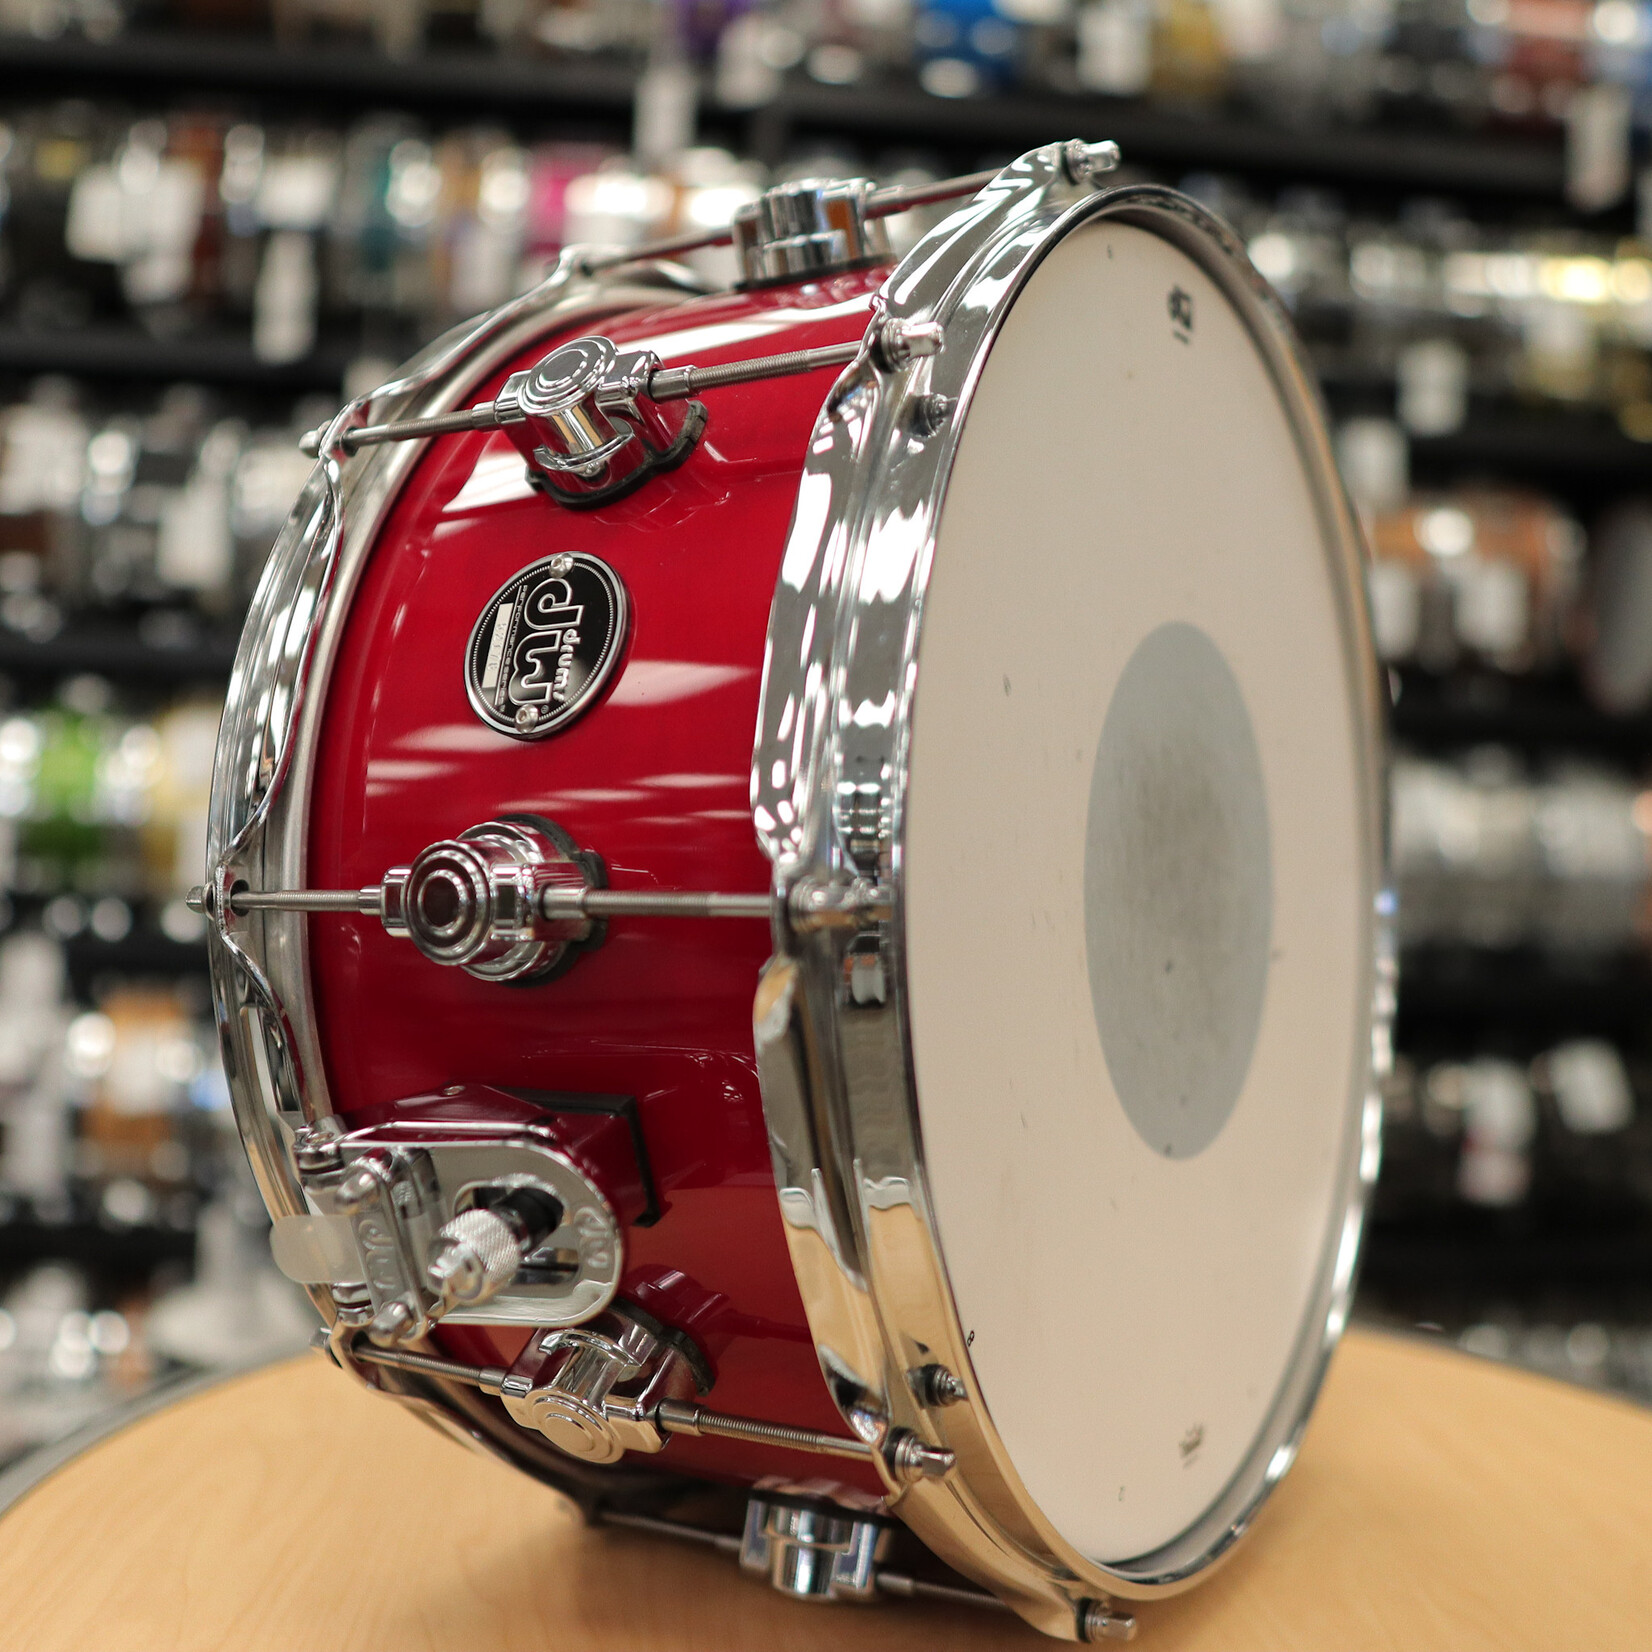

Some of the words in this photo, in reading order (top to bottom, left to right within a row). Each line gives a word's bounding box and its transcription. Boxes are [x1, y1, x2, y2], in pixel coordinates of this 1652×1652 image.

[506, 584, 528, 666] performance
[508, 577, 585, 705] dw
[552, 629, 582, 703] drums
